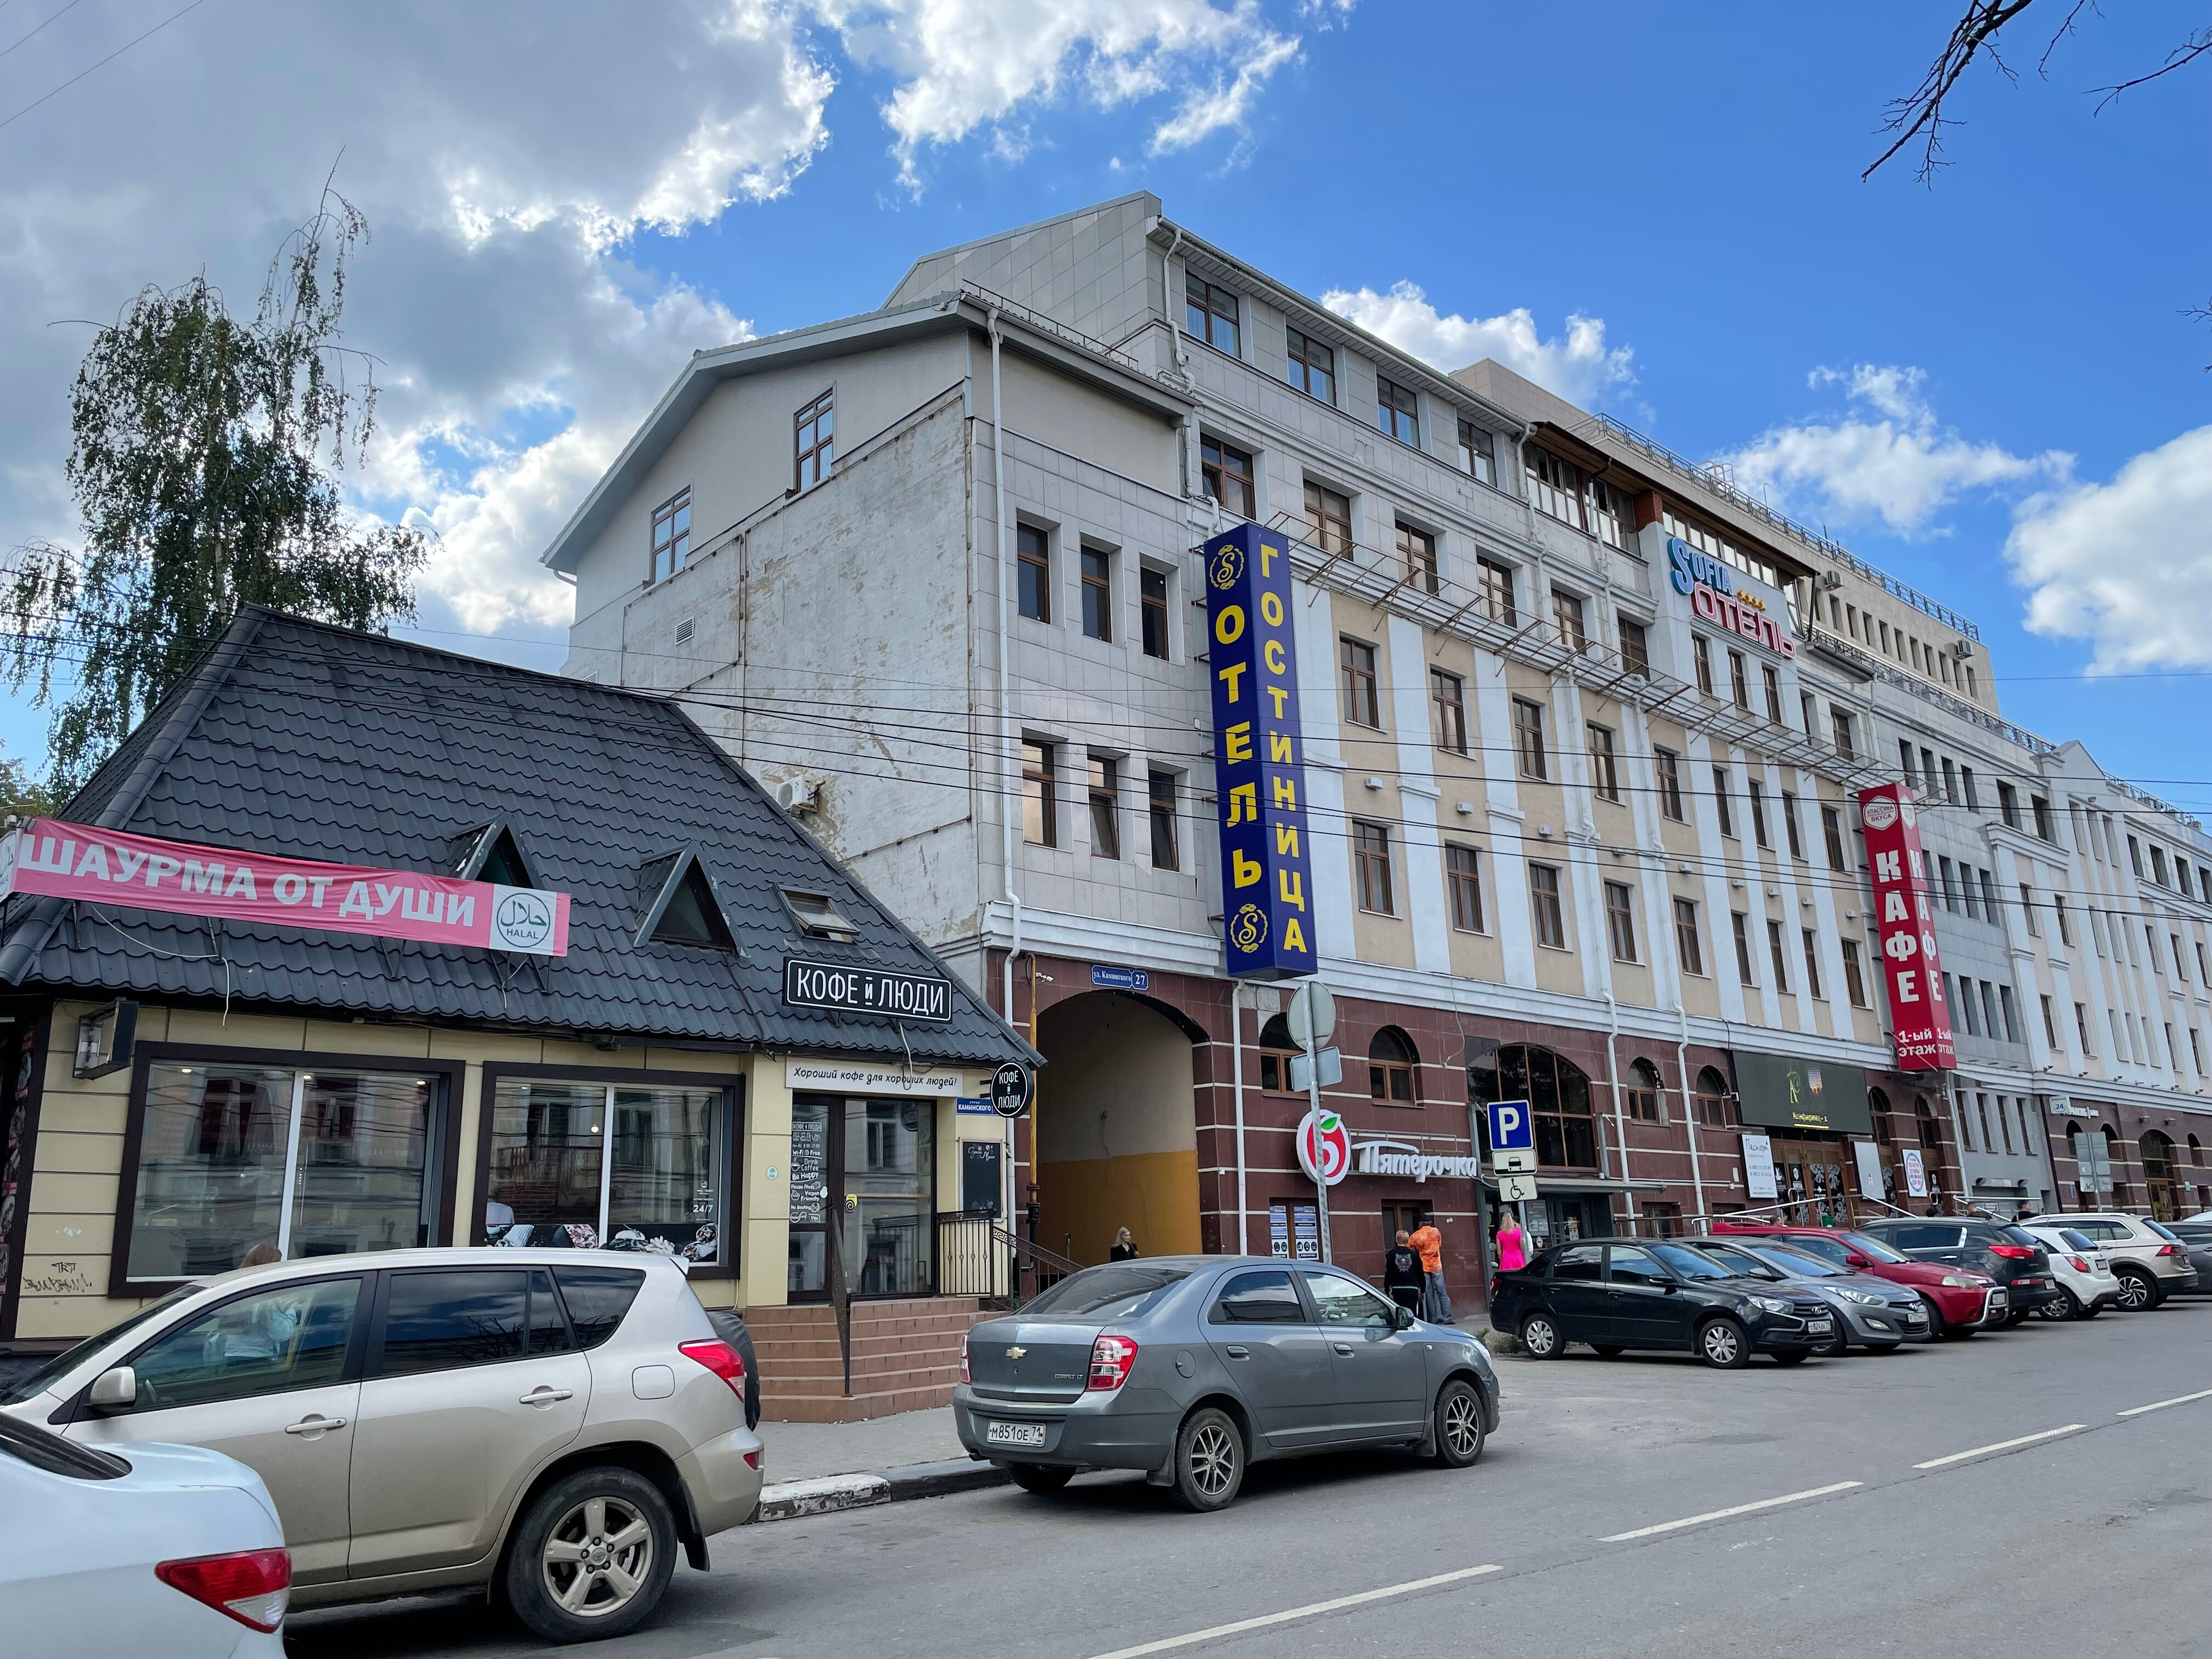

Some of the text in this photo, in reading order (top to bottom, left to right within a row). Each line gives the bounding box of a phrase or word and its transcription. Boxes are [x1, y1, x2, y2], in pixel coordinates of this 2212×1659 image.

[1691, 582, 1796, 659] ОТЕЛЬ
[1215, 605, 1261, 889] ОТЕЛЬ
[1260, 544, 1307, 952] ГОСТИНИЦА
[1867, 805, 1894, 815] КЛАССИКА
[1871, 814, 1892, 822] ВКУСА
[17, 833, 257, 900] ШАУРМА
[273, 874, 334, 908] ОТ
[339, 884, 475, 926] ДУШИ
[501, 900, 546, 927] حلال
[1876, 849, 1920, 1003] КАФЕ
[1909, 849, 1942, 1001] КАФЕ
[506, 928, 539, 939] HALAL
[1102, 970, 1131, 981] Каминского
[1135, 974, 1145, 985] 27
[797, 968, 859, 1003] КОФЕ
[878, 979, 943, 1015] ЛЮДИ
[1899, 1028, 1932, 1043] 1-ый
[1899, 1044, 1937, 1057] этаж
[1938, 1043, 1954, 1055] этаж
[794, 1068, 956, 1089] Хороший кофе для хороших людей!
[999, 1070, 1018, 1084] КОФЕ
[998, 1094, 1020, 1109] ЛЮДИ
[693, 1204, 713, 1212] 24/7
[1032, 1426, 1041, 1437] 71
